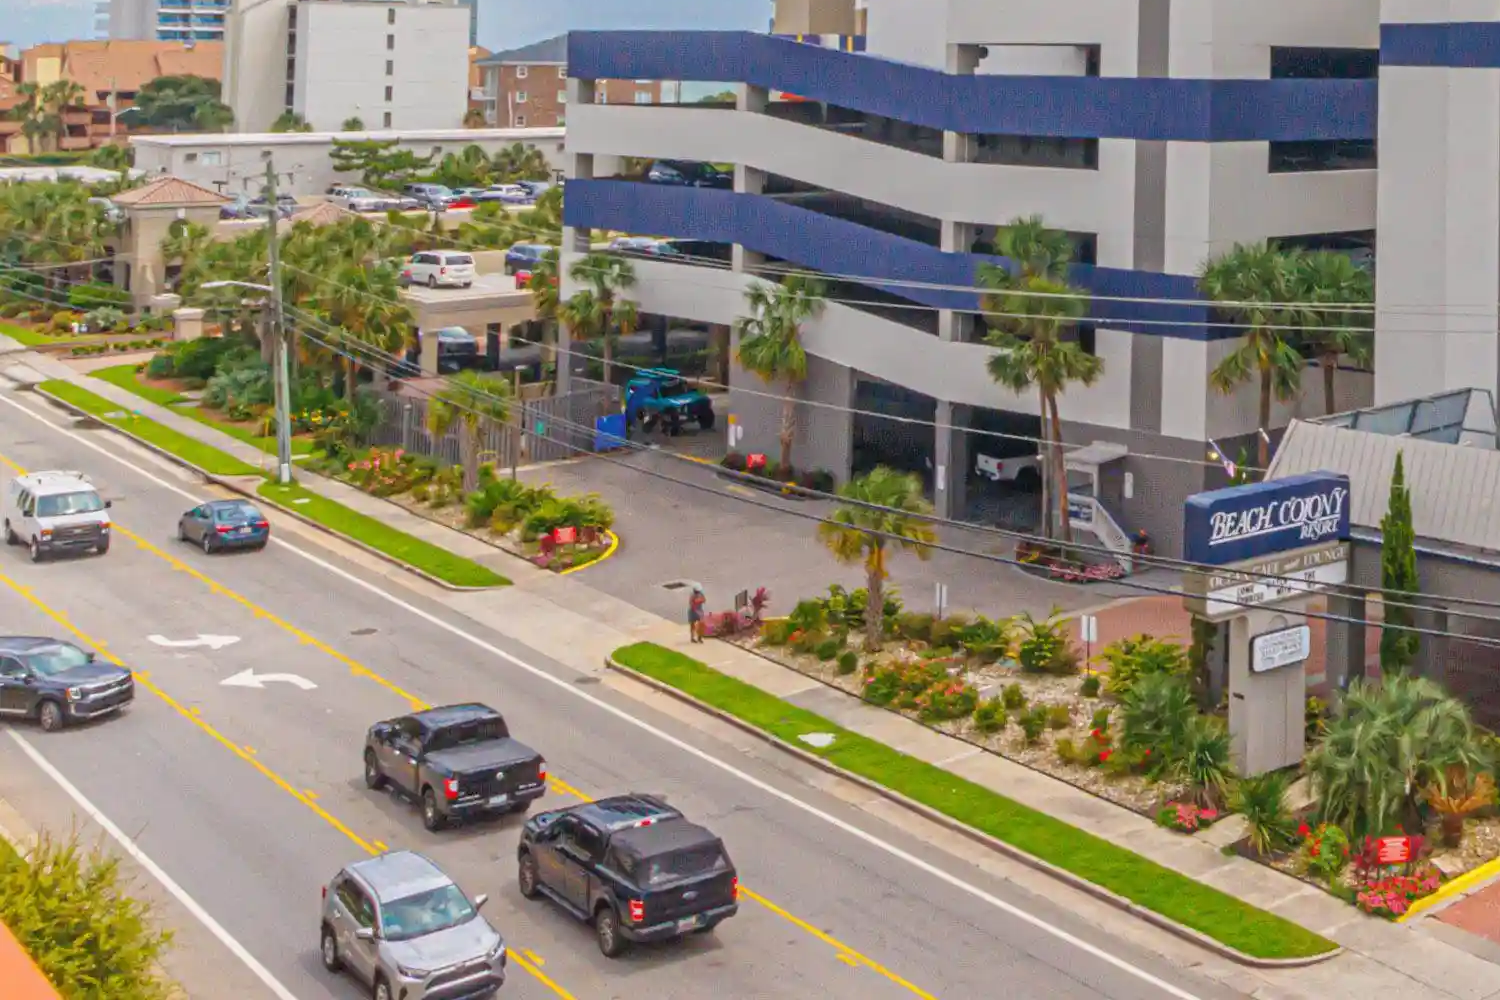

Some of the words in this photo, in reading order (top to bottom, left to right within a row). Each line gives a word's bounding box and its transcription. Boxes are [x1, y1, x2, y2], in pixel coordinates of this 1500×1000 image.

[1210, 501, 1278, 541] BEACH
[1279, 487, 1347, 526] COLONY
[1299, 518, 1340, 541] RESORT
